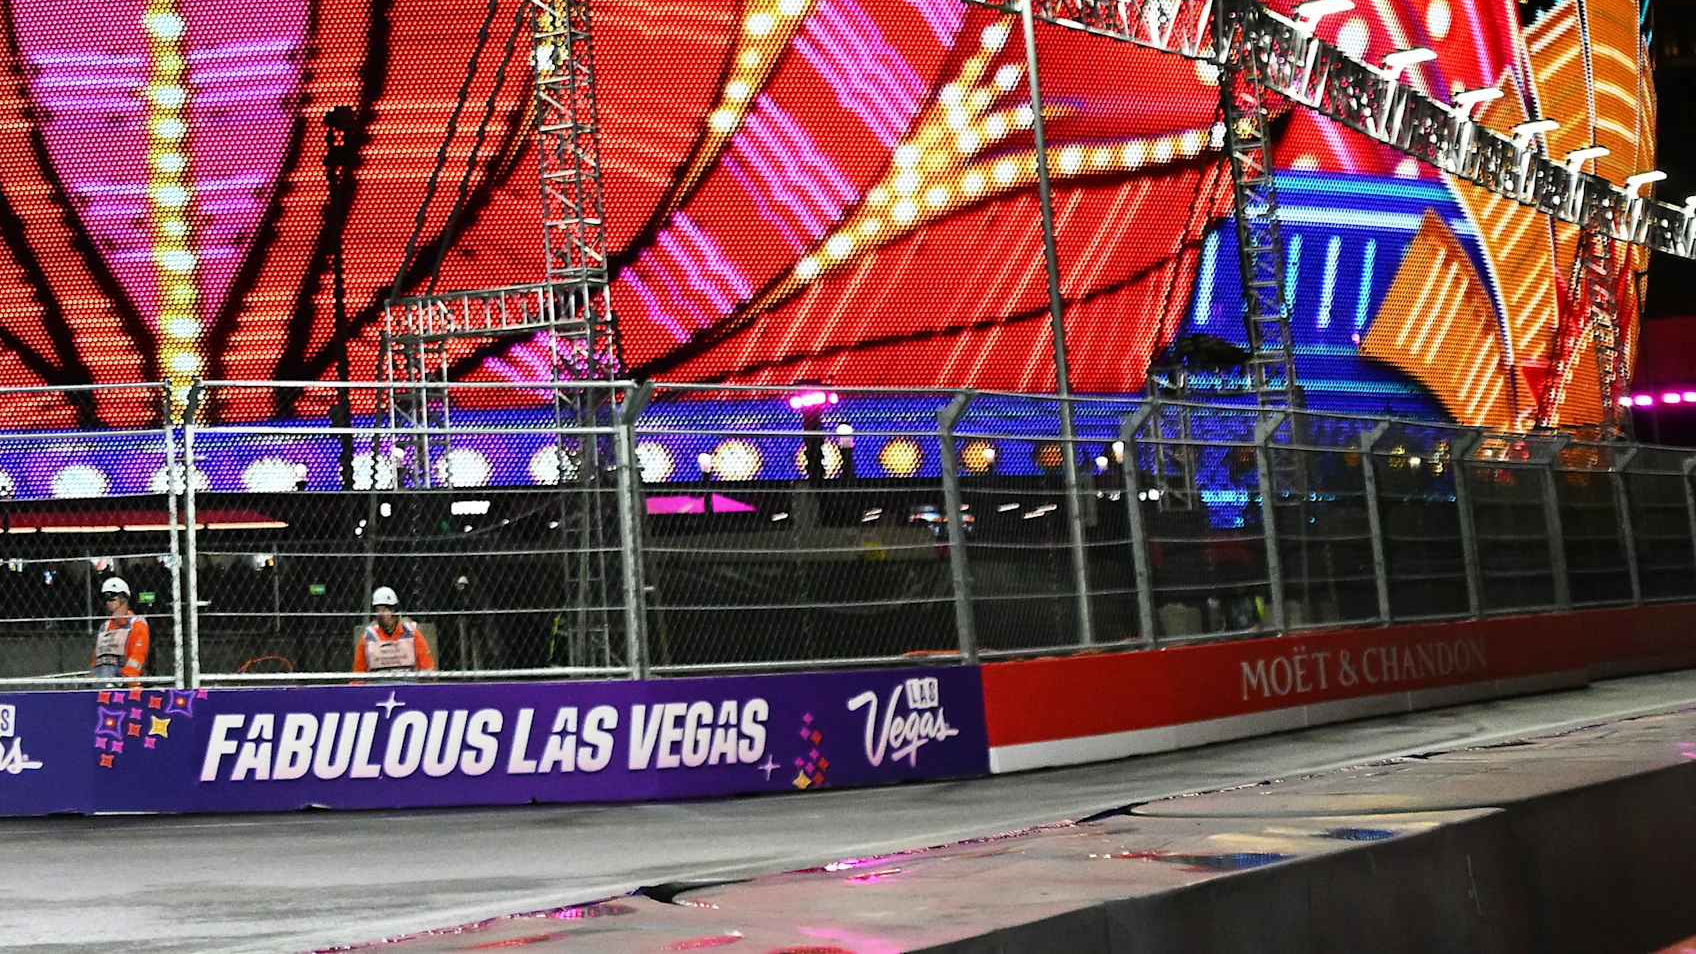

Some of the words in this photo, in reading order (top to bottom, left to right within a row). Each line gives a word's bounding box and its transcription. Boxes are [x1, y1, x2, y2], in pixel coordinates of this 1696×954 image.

[908, 680, 937, 706] LAS
[1240, 646, 1332, 701] MOËT
[1339, 649, 1358, 687] &
[1361, 637, 1487, 685] CHANDON
[200, 707, 505, 782] FABULOUS
[506, 705, 619, 776] LAS
[626, 697, 770, 772] VEGAS
[847, 684, 960, 768] Vegas
